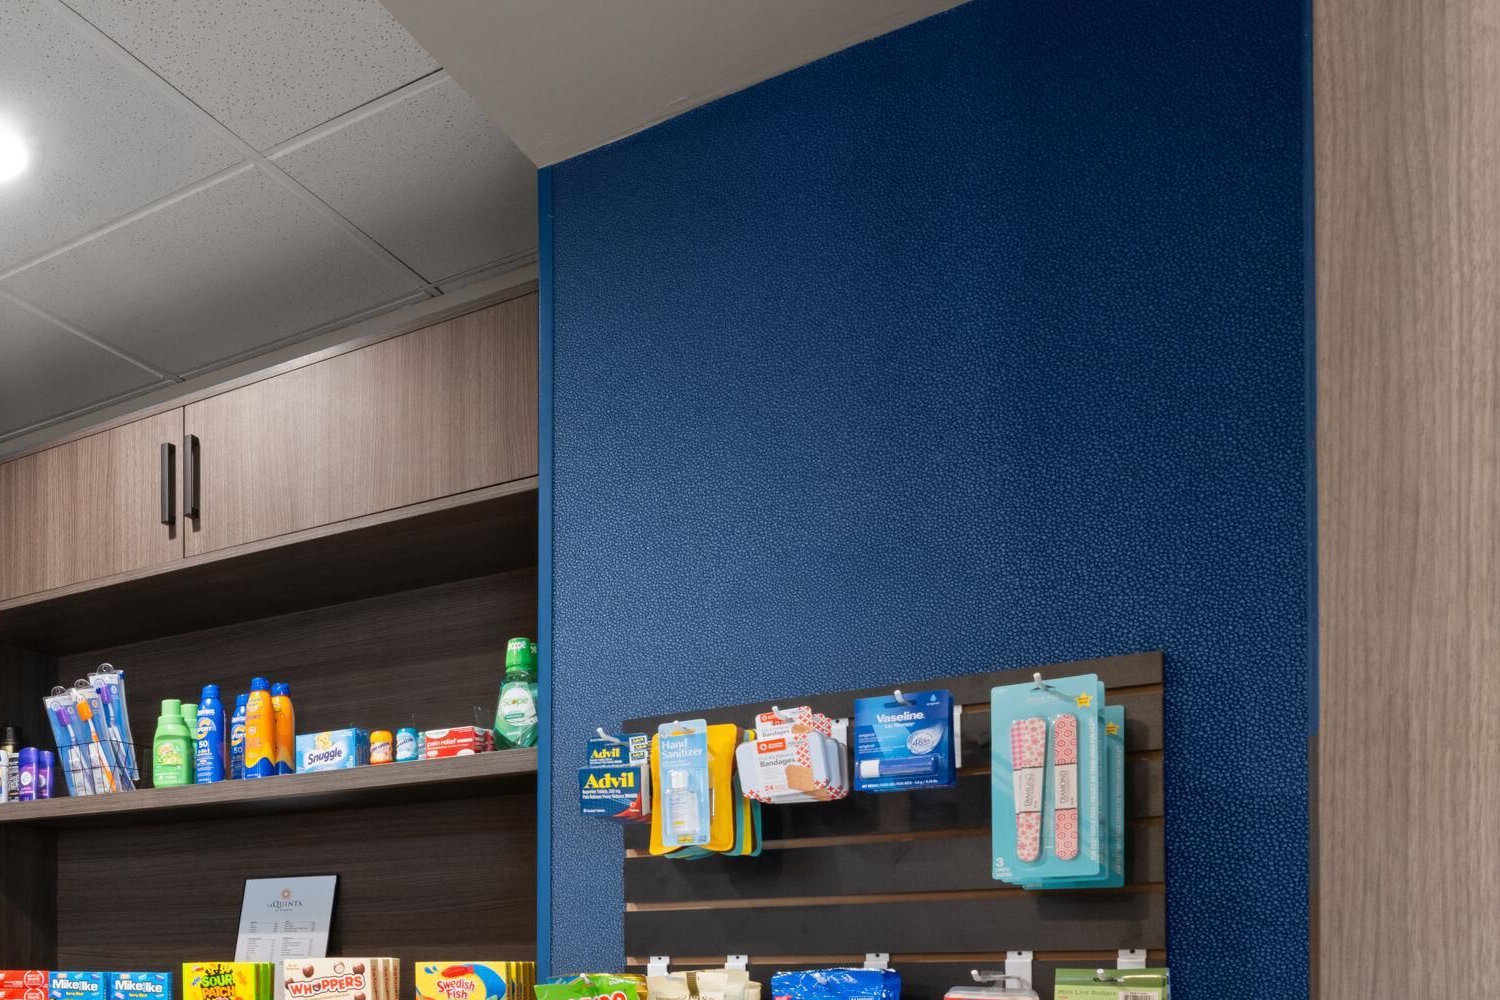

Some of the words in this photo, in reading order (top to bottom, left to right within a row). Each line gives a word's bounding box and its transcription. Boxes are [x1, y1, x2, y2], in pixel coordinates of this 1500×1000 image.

[503, 698, 529, 707] Scope
[876, 711, 924, 723] Vaseline
[762, 729, 790, 738] Bandages
[662, 738, 688, 749] Hand
[308, 748, 342, 766] Snuggle
[591, 748, 620, 758] Advil
[662, 748, 702, 760] Sanitizer
[760, 758, 796, 768] Bandages
[584, 772, 634, 789] Advil
[1059, 770, 1067, 804] DIAMOND
[996, 857, 1004, 867] 3
[272, 900, 303, 909] QUINTA
[52, 979, 79, 990] Mike
[81, 981, 98, 991] Ike
[202, 974, 234, 985] SOUR
[290, 974, 364, 997] WHOPPERS
[437, 979, 475, 992] Swedish
[115, 980, 143, 991] Mike
[146, 982, 162, 993] Ike
[202, 986, 236, 1000] PATCH
[446, 990, 468, 999] Fish
